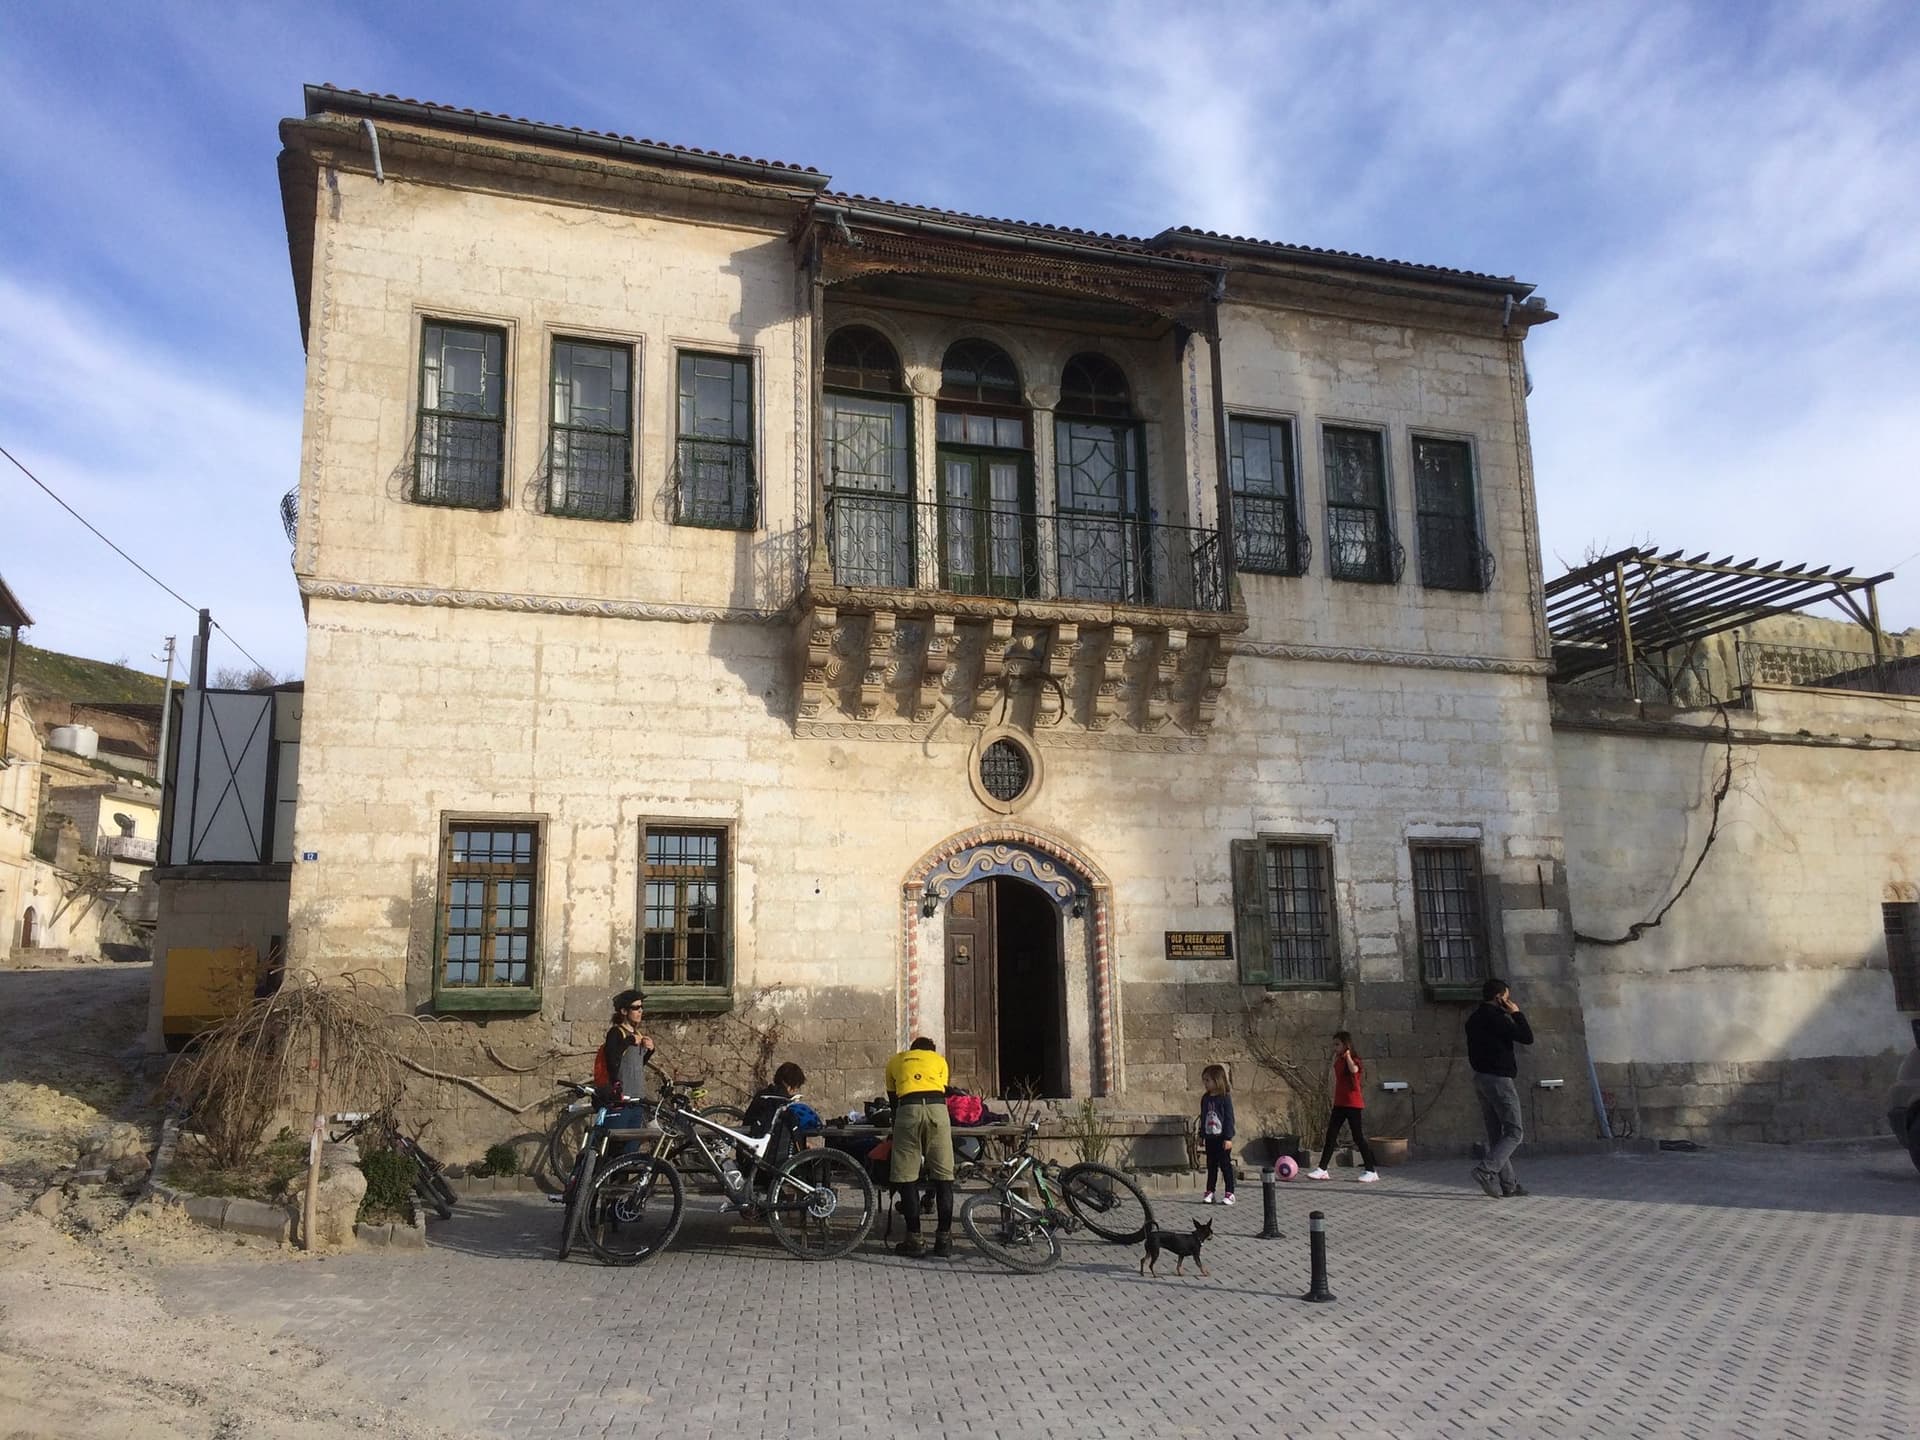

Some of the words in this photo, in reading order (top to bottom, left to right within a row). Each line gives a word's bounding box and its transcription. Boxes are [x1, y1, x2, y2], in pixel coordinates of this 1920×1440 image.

[1170, 934, 1183, 944] OLD
[1184, 934, 1204, 944] GREEK
[1206, 934, 1225, 944] HOUSE
